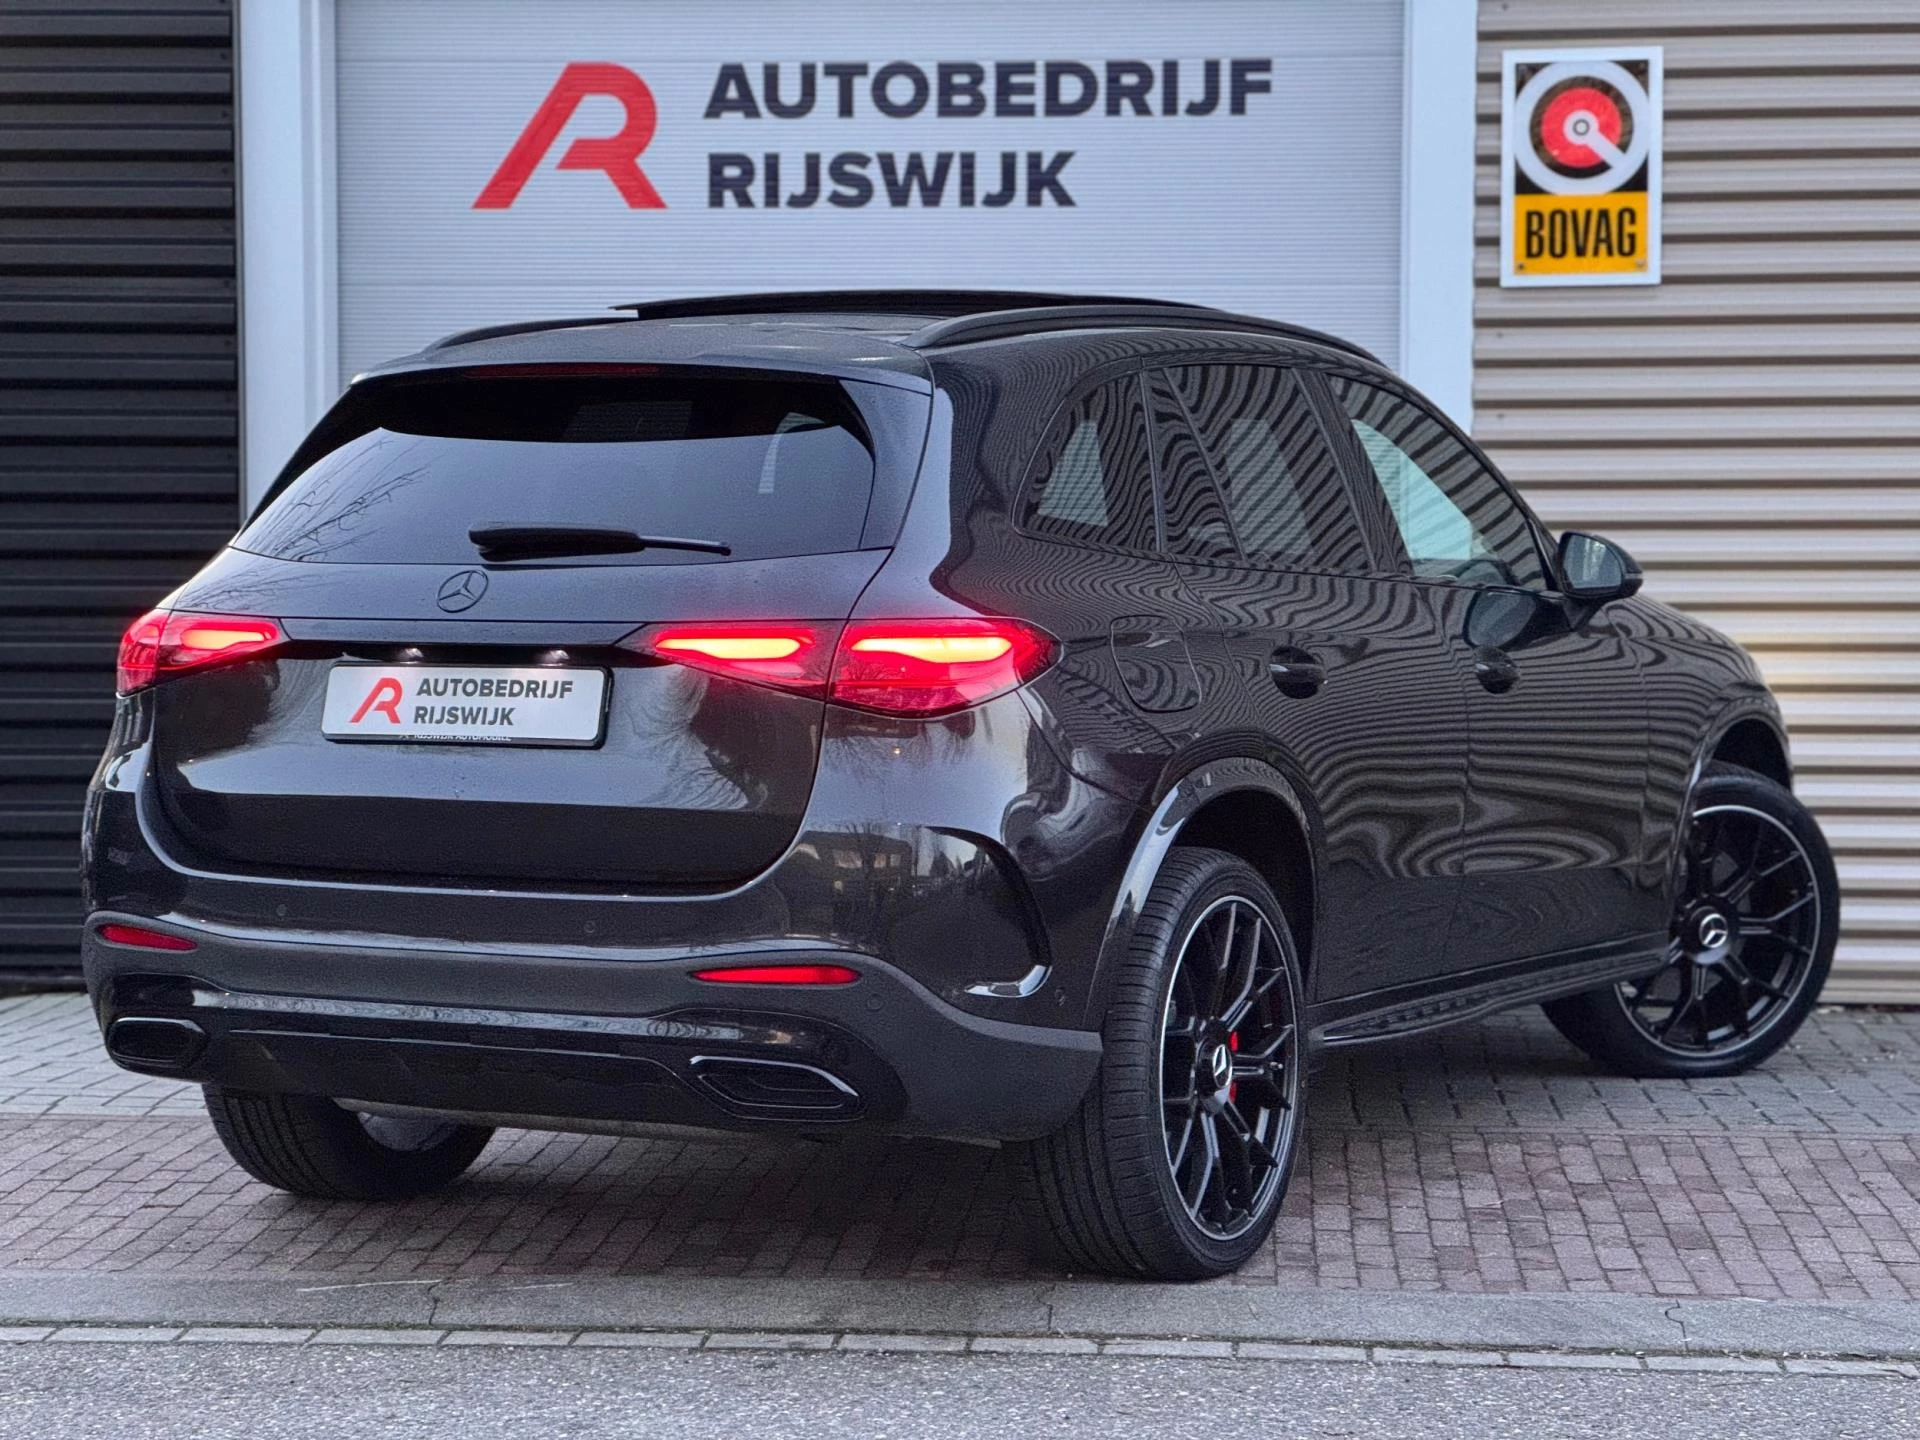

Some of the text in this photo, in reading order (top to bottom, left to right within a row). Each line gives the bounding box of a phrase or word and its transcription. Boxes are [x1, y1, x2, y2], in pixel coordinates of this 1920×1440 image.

[703, 59, 1273, 119] AUTOBEDRIJF
[708, 152, 1077, 209] RIJSWIJK
[1525, 207, 1637, 259] BOVAG
[416, 678, 574, 699] AUTOBEDRIJF
[413, 706, 515, 726] RIJSWIJK
